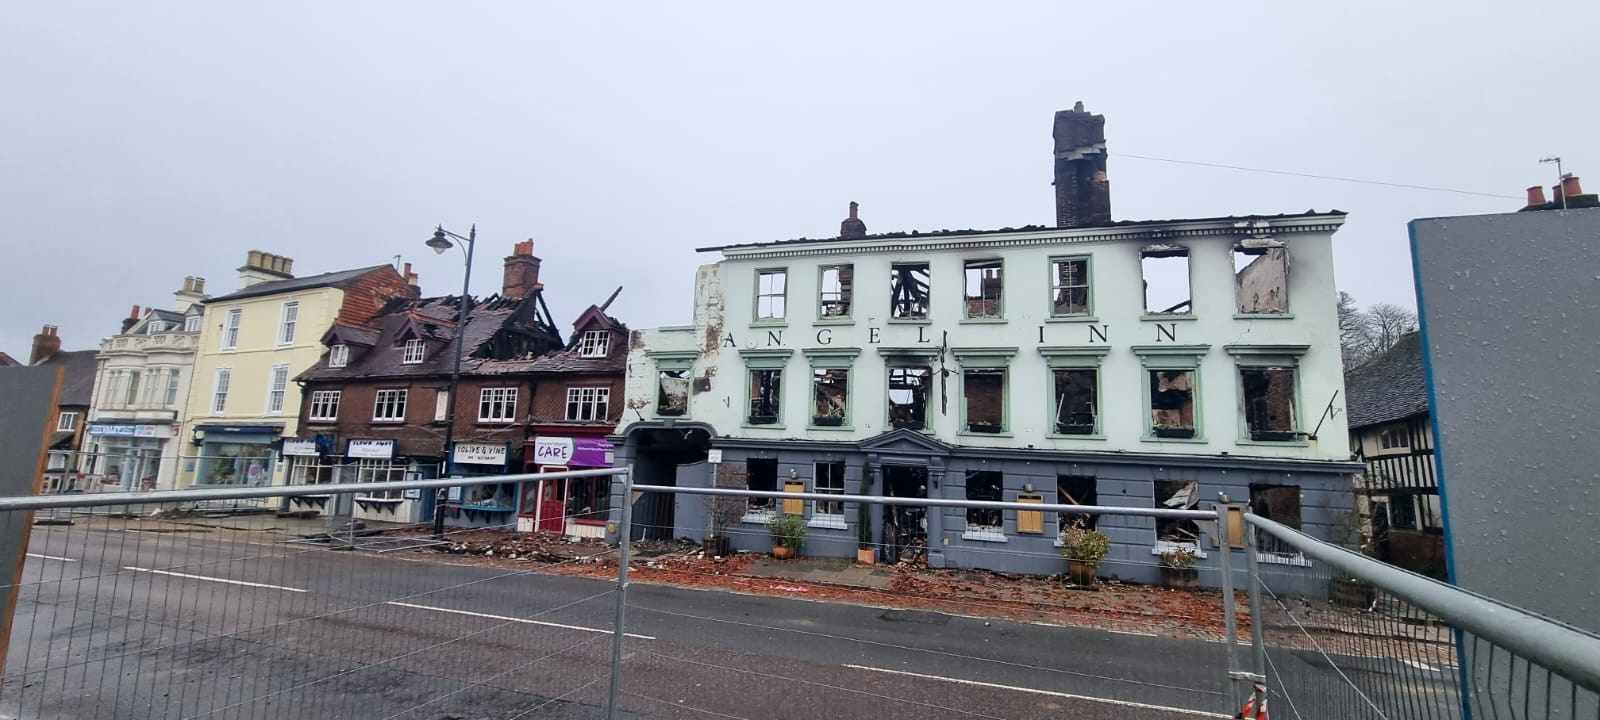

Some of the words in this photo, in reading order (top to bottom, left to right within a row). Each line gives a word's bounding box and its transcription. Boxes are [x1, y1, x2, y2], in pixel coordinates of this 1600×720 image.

[723, 326, 930, 347] ANGEL
[1038, 323, 1177, 343] INN
[489, 447, 505, 455] VINE
[537, 446, 567, 459] CARE
